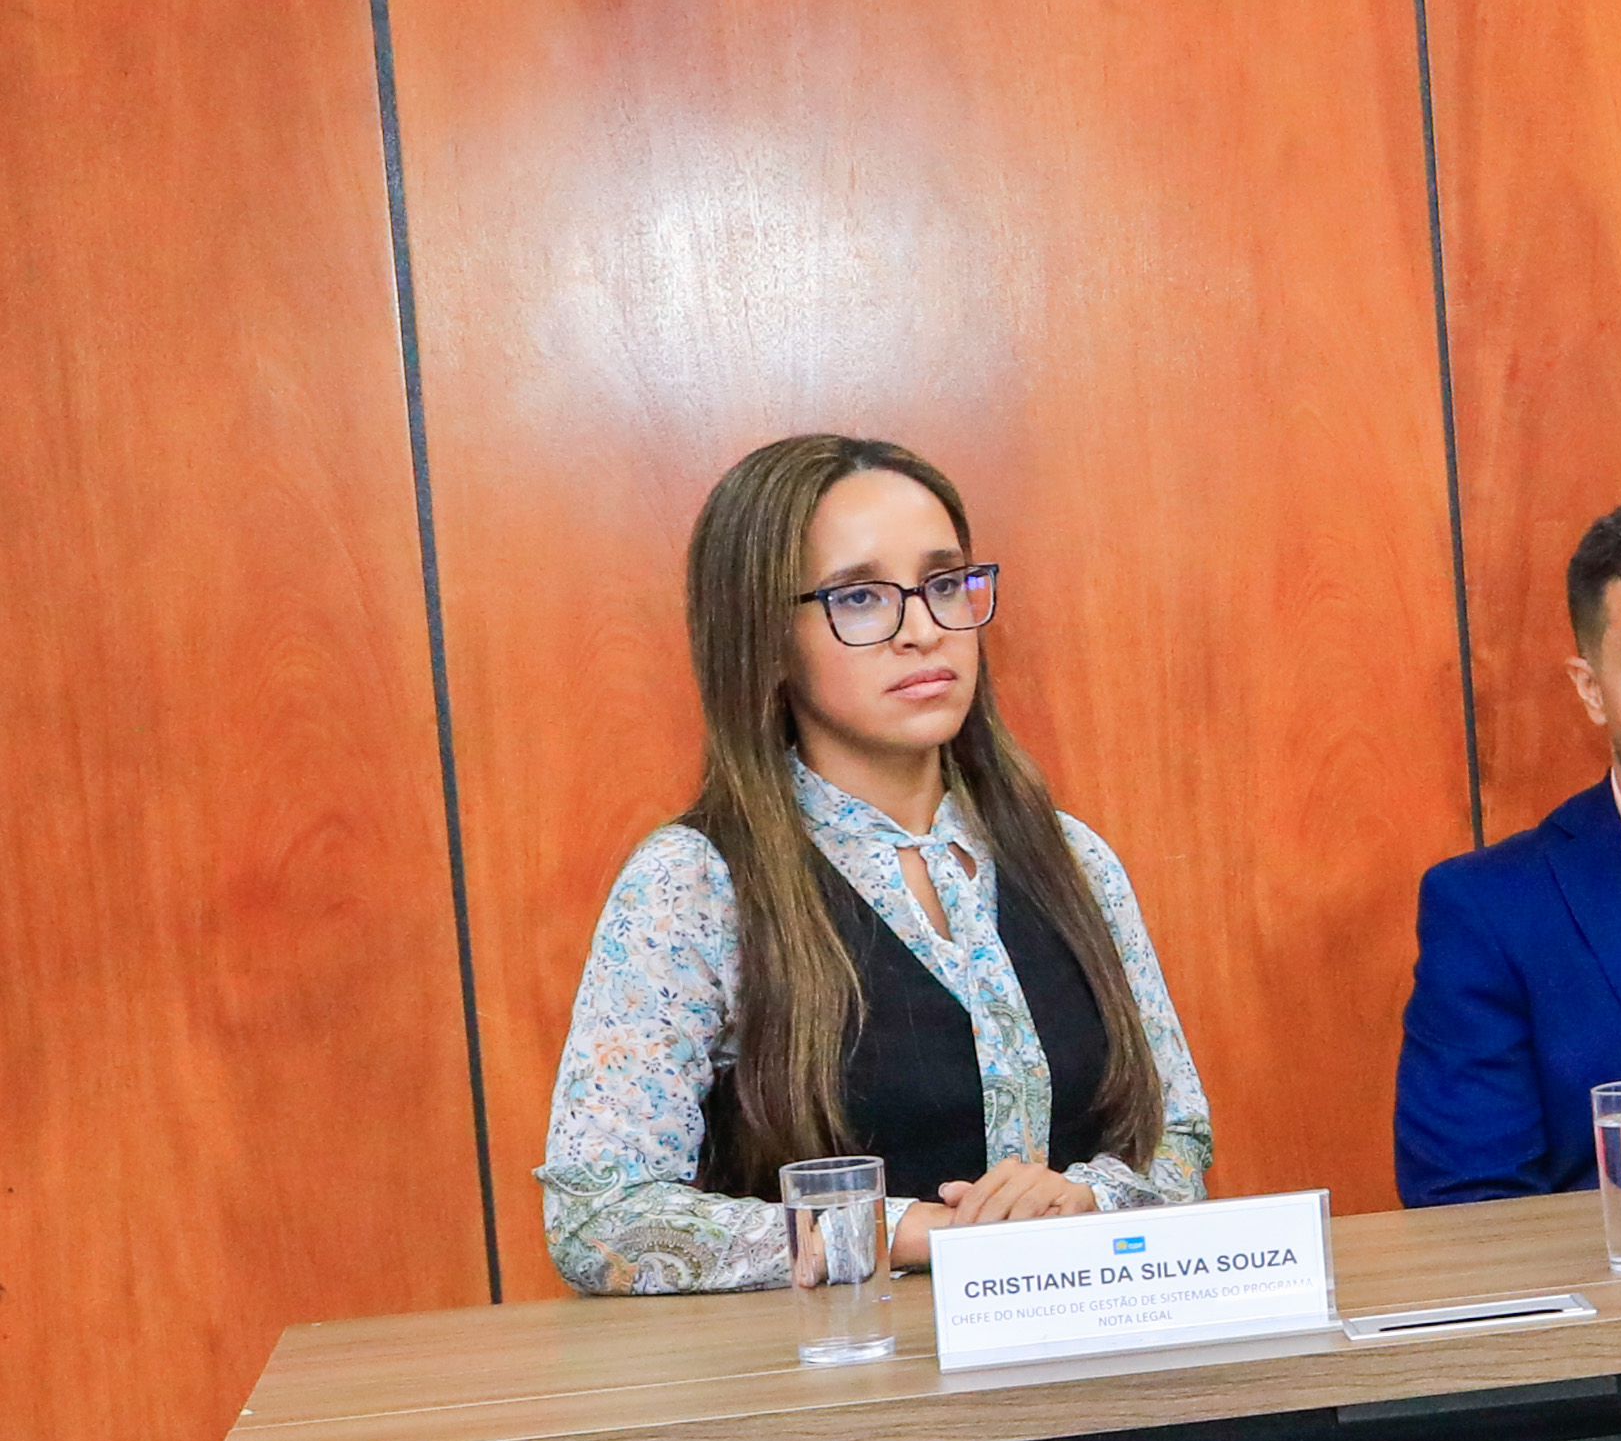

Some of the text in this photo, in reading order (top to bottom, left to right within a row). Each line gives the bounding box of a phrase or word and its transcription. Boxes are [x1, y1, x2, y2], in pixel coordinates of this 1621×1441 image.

[964, 1248, 1298, 1298] CRISTIANE DA SILVA SOUZA
[951, 1311, 990, 1326] CHEFE
[994, 1309, 1013, 1322] DO
[1070, 1301, 1085, 1314] DE
[1089, 1294, 1138, 1311] GESTÃO
[1141, 1294, 1157, 1306] DE
[1160, 1287, 1219, 1303] SISTEMAS
[1222, 1285, 1240, 1297] DO
[1098, 1310, 1173, 1327] NOTA LEGAL
